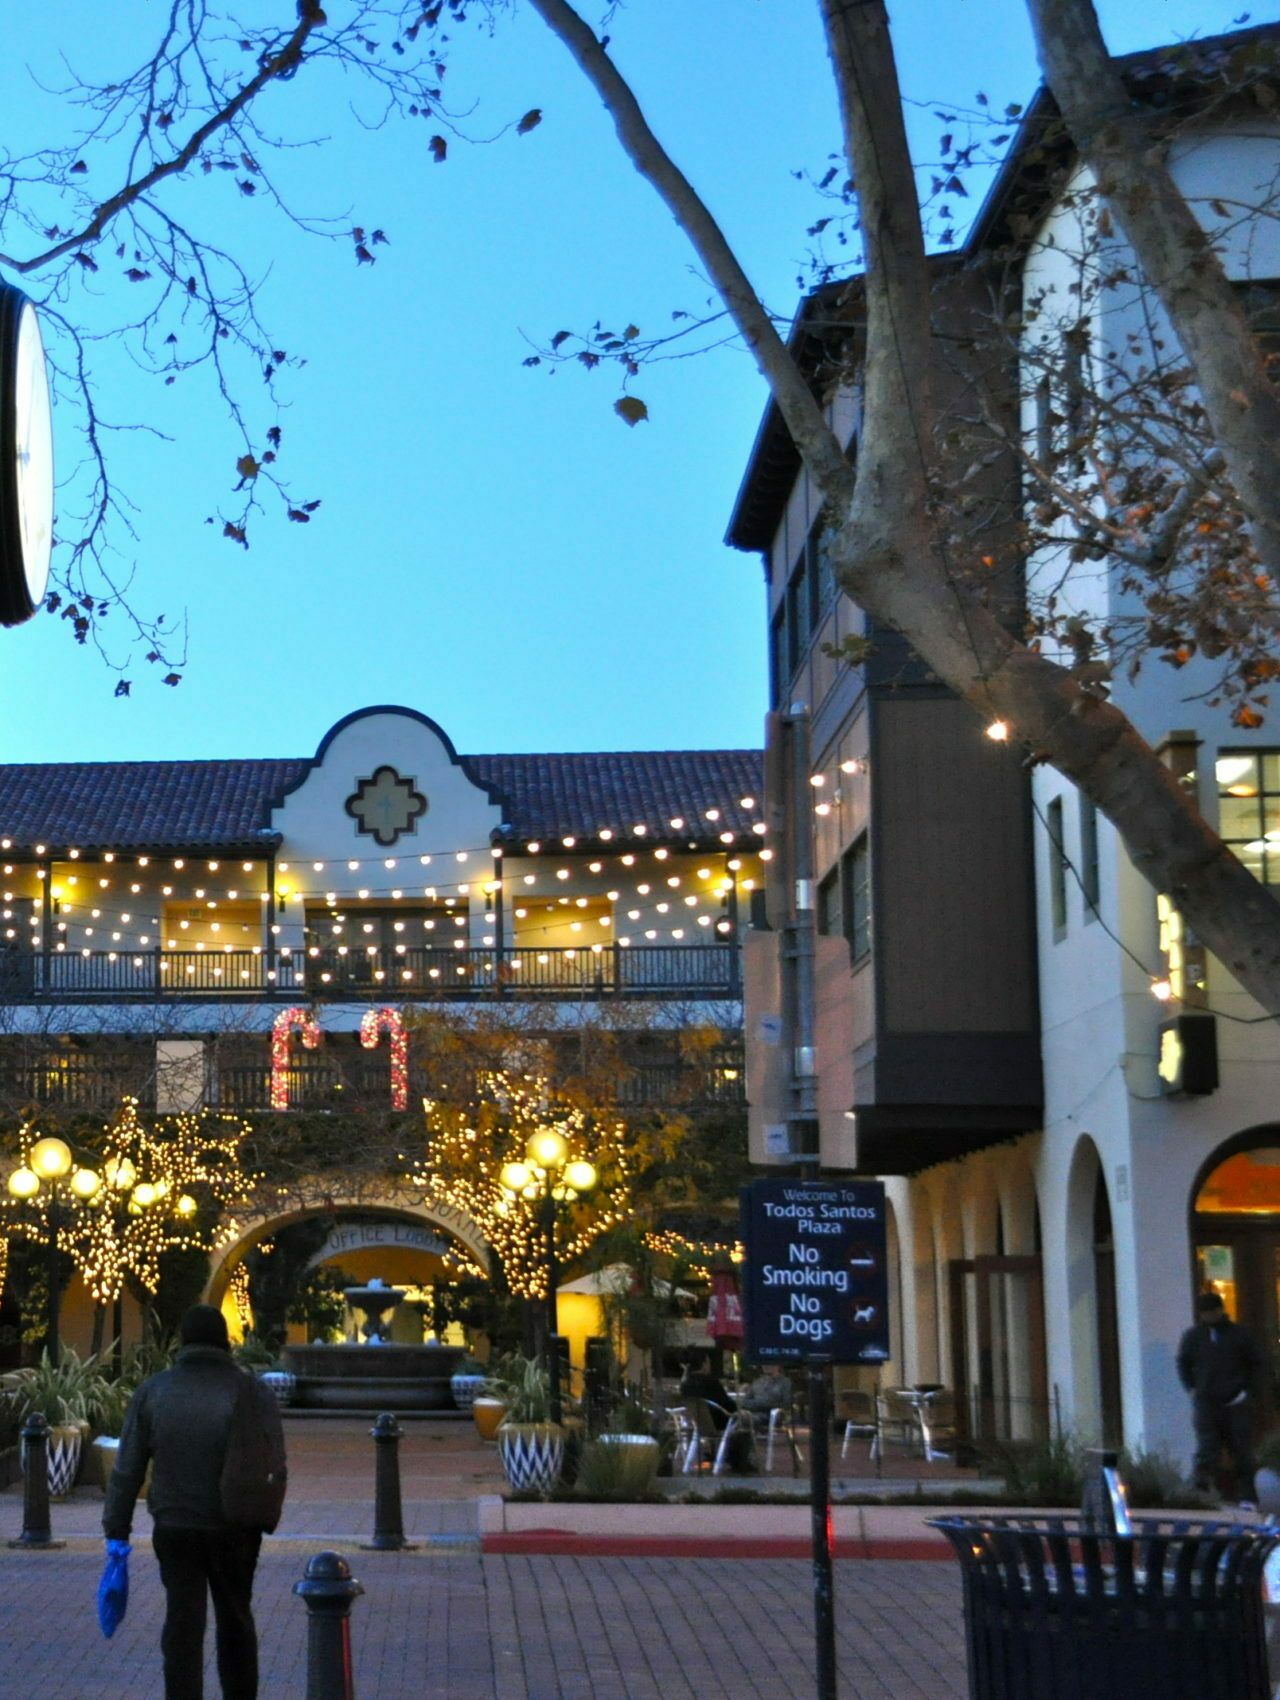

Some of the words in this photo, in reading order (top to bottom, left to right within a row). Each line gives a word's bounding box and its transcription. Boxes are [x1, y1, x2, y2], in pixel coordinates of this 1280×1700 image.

[783, 1189, 838, 1202] Welcome
[841, 1189, 856, 1202] To
[763, 1202, 815, 1218] Todos
[820, 1203, 877, 1219] Santos
[798, 1219, 842, 1234] Plaza
[328, 1225, 384, 1250] OFFICE
[789, 1243, 820, 1264] No
[762, 1265, 849, 1292] Smoking
[790, 1293, 821, 1313] No
[780, 1314, 833, 1341] Dogs
